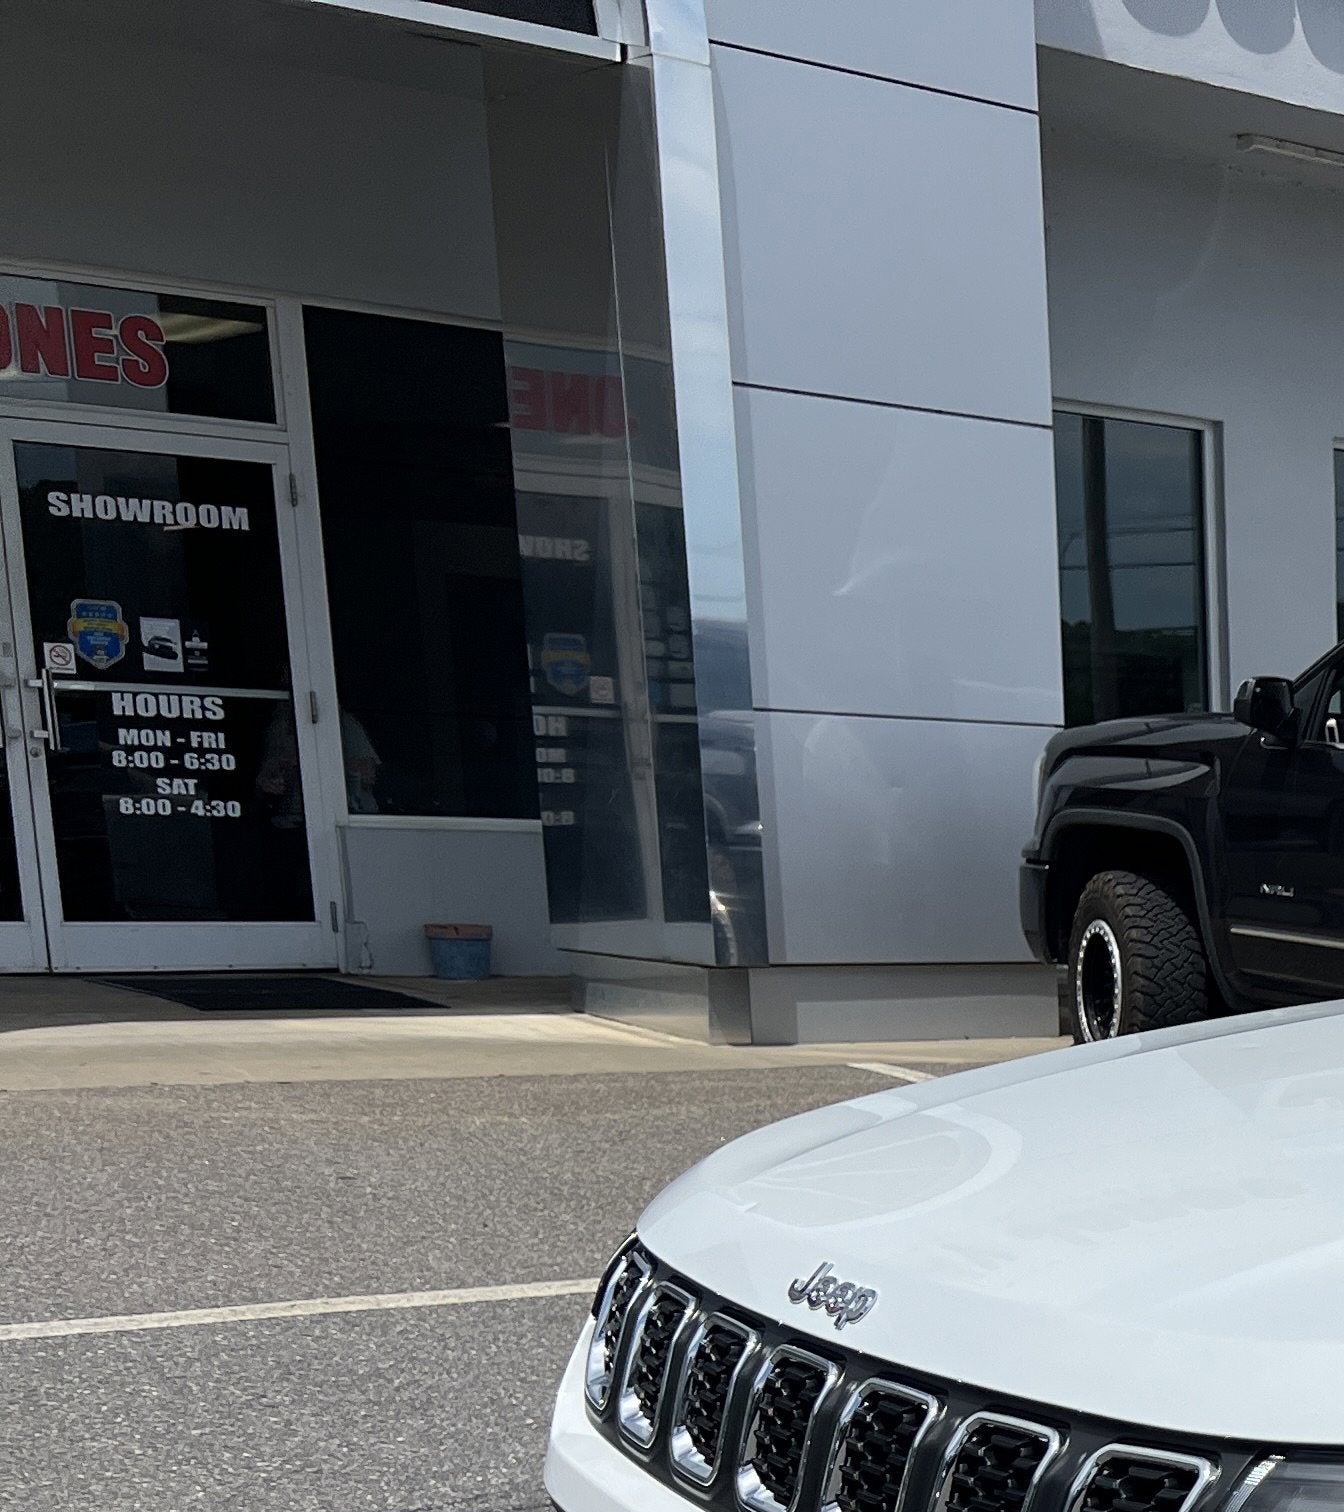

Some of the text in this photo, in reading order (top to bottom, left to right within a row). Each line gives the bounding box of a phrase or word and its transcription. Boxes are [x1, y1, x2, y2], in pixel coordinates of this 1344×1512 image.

[0, 301, 169, 389] NES
[47, 491, 250, 531] SHOWROOM
[112, 692, 225, 721] HOURS
[118, 728, 172, 747] MON
[190, 731, 226, 749] FRI
[112, 750, 165, 769] 8:00
[184, 752, 236, 771] 6:30
[156, 777, 198, 795] SAT
[119, 797, 172, 816] 8:00
[190, 799, 241, 818] 4:30
[788, 1261, 878, 1331] Jeep
